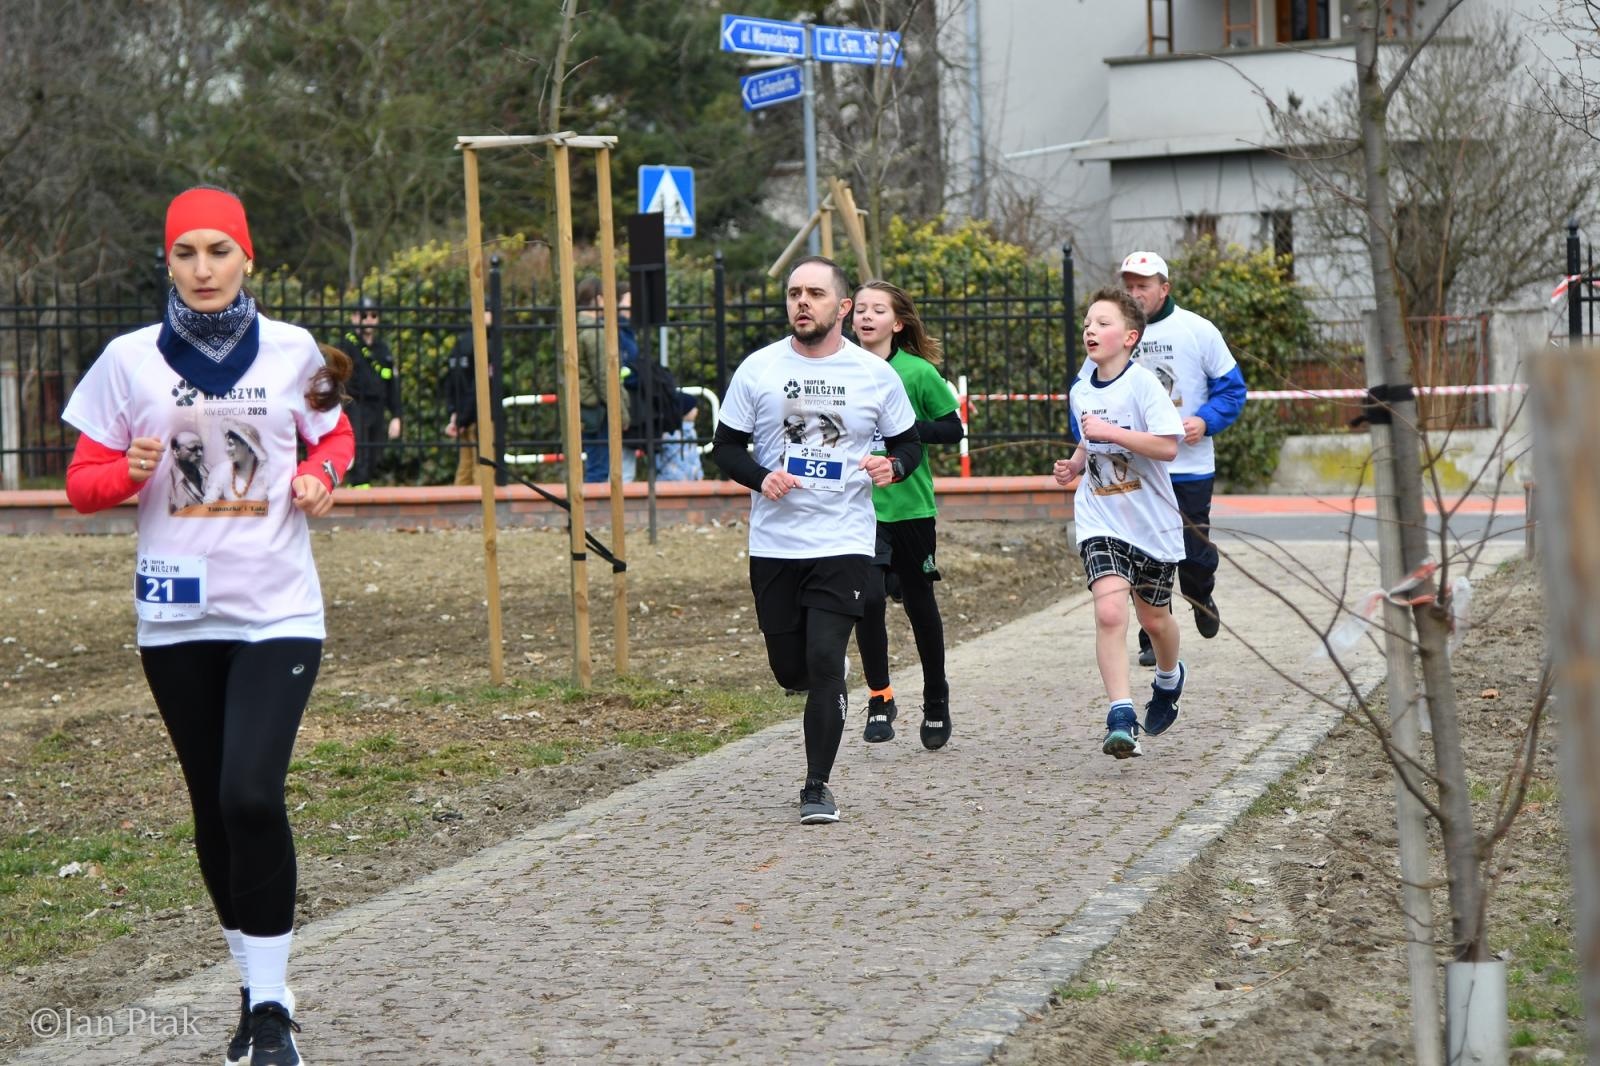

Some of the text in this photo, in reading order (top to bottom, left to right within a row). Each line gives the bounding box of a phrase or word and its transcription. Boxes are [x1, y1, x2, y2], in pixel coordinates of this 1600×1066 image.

[824, 32, 837, 51] ul.
[1143, 345, 1173, 353] WILCZYM
[804, 386, 846, 395] WILCZYM
[217, 407, 246, 416] EDYCJA
[247, 407, 267, 416] 2026
[804, 460, 827, 477] 56
[150, 565, 179, 573] WILCZYM
[145, 577, 173, 602] 21
